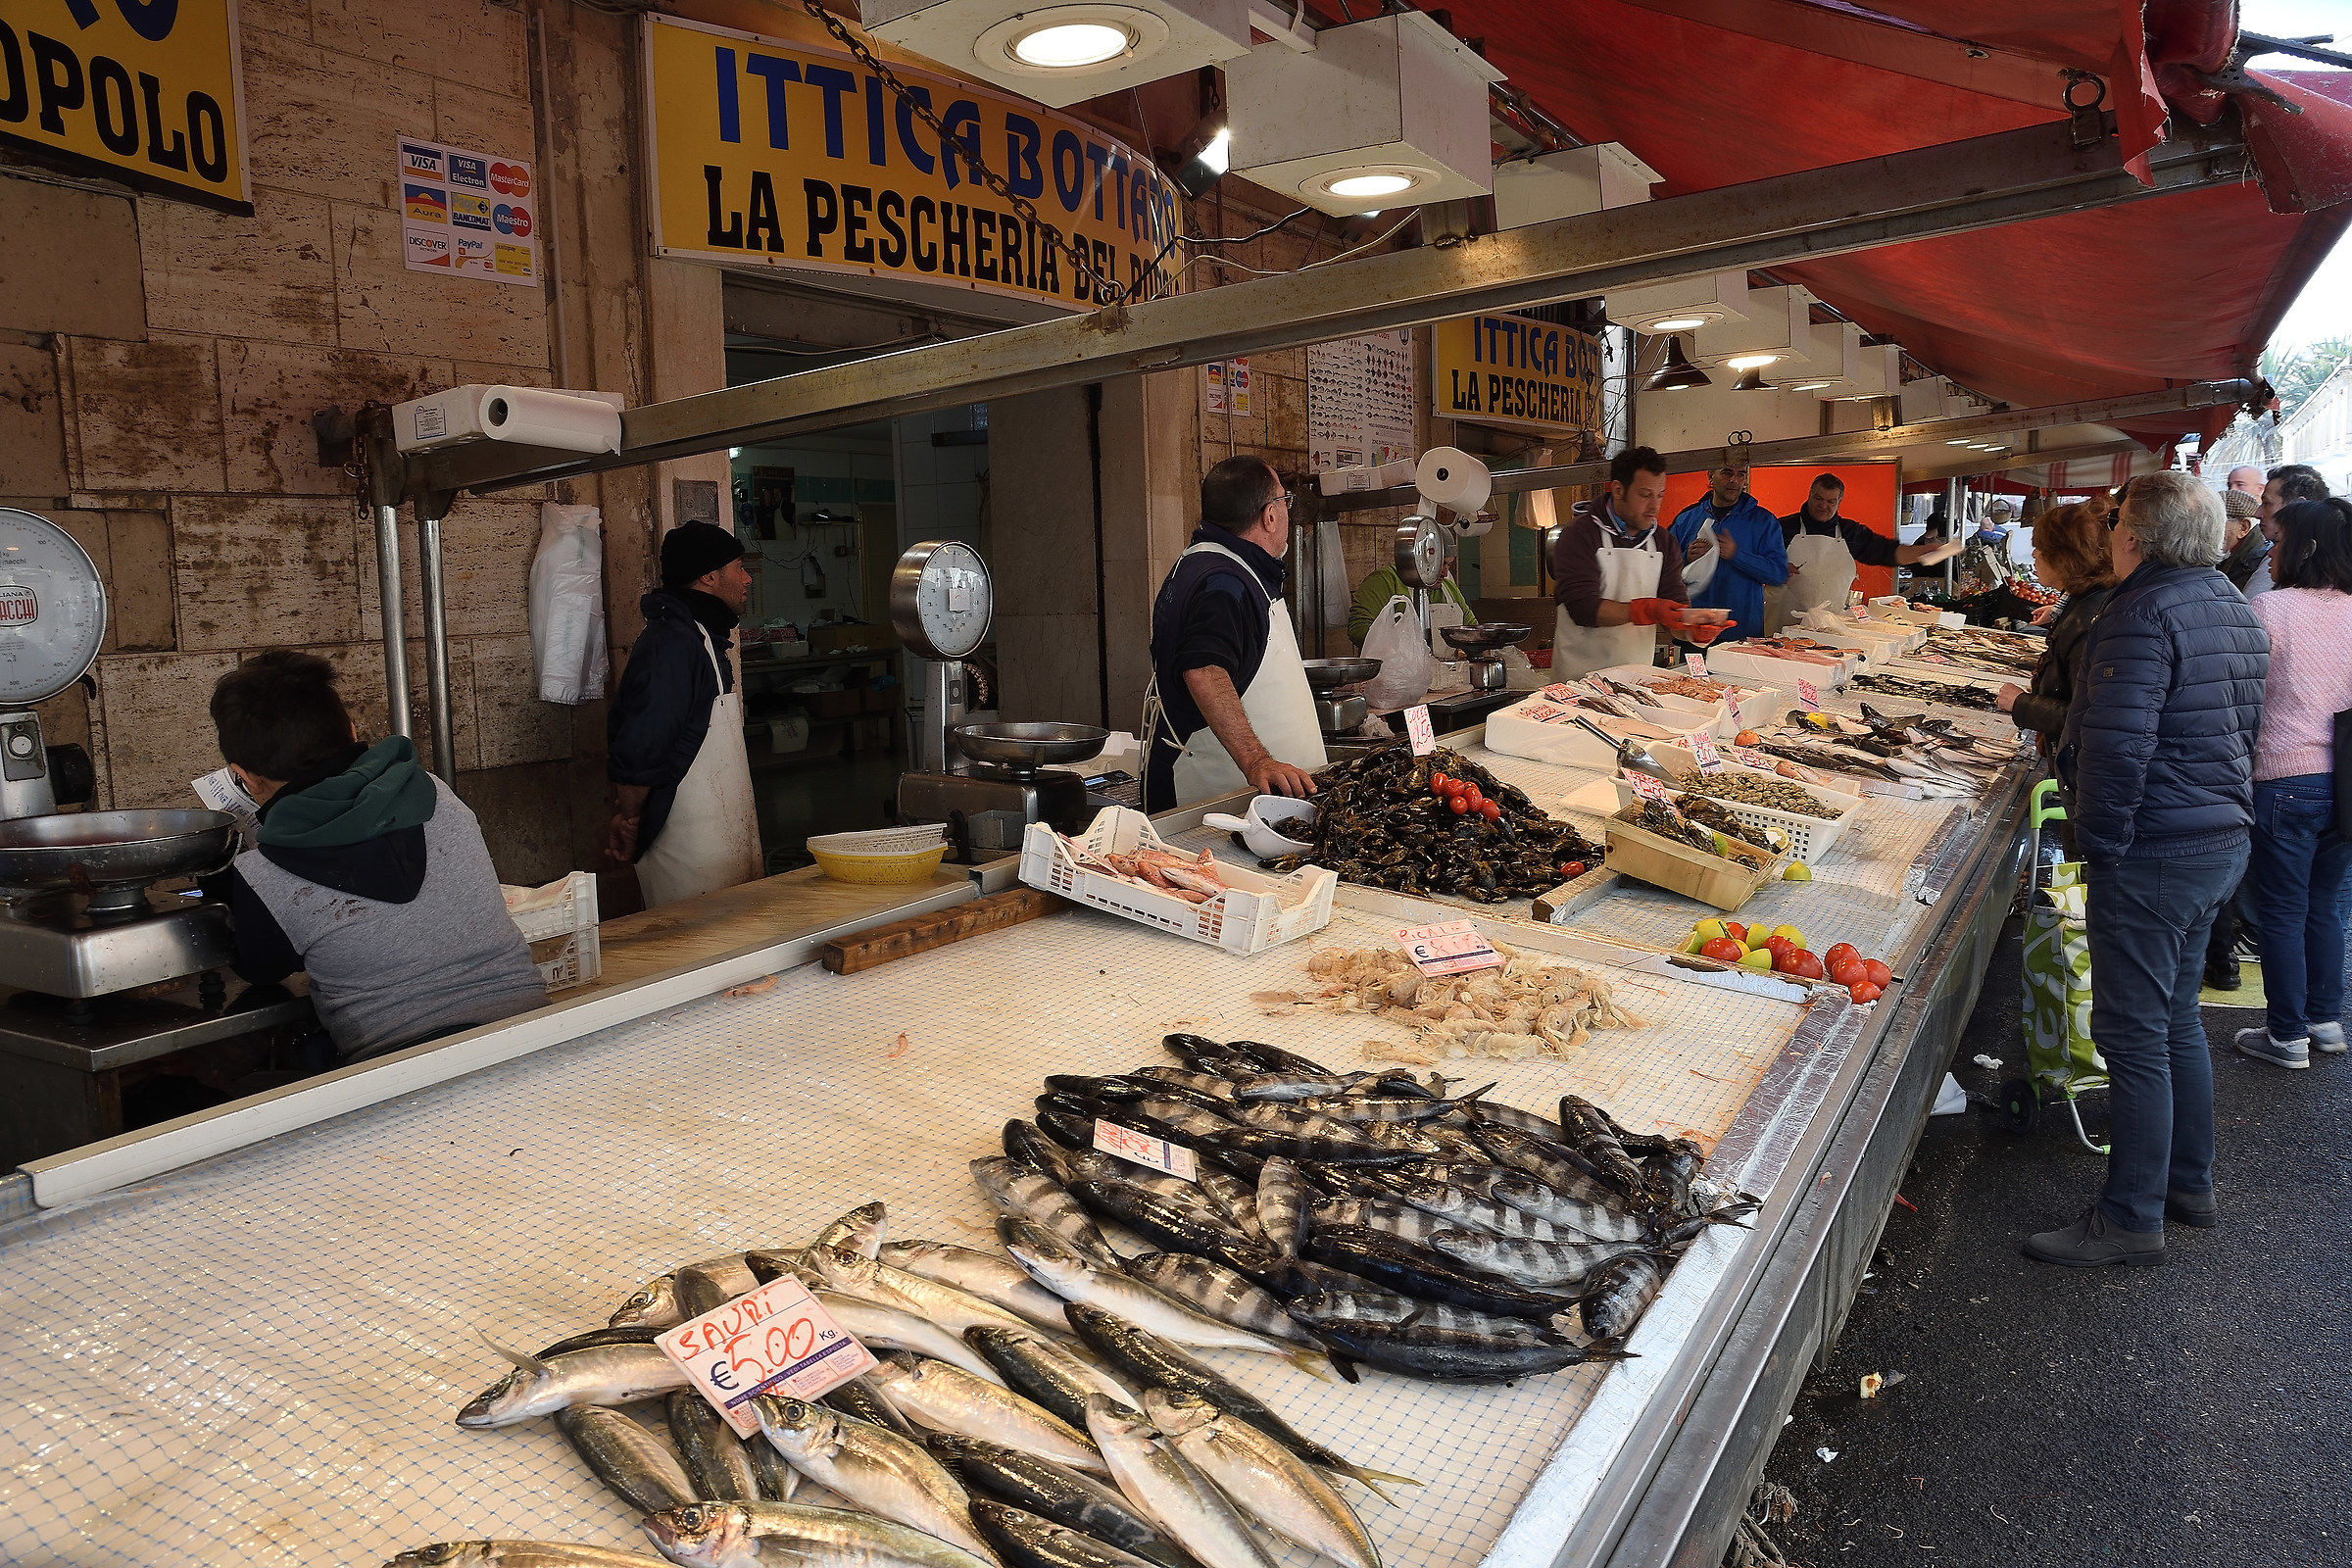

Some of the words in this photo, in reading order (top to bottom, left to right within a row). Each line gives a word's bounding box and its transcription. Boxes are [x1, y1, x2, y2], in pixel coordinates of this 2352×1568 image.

[715, 46, 981, 191] ITTICA
[1004, 112, 1176, 261] BOTTARO
[411, 154, 437, 172] VISA
[458, 159, 476, 171] VISA
[452, 172, 485, 186] Electron
[490, 172, 530, 188] MasterCard
[413, 207, 442, 219] Aura
[453, 212, 490, 226] BANCOMAT
[496, 214, 529, 227] Maestro
[704, 165, 784, 253] LA
[803, 177, 1059, 294] PESCHERIA
[409, 236, 447, 250] DISCOVER
[458, 238, 483, 250] PayPal
[1474, 317, 1558, 378] ITTICA
[1451, 369, 1481, 412] LA
[1488, 373, 1581, 426] PESCHERIA
[800, 1352, 824, 1368] TABELLA
